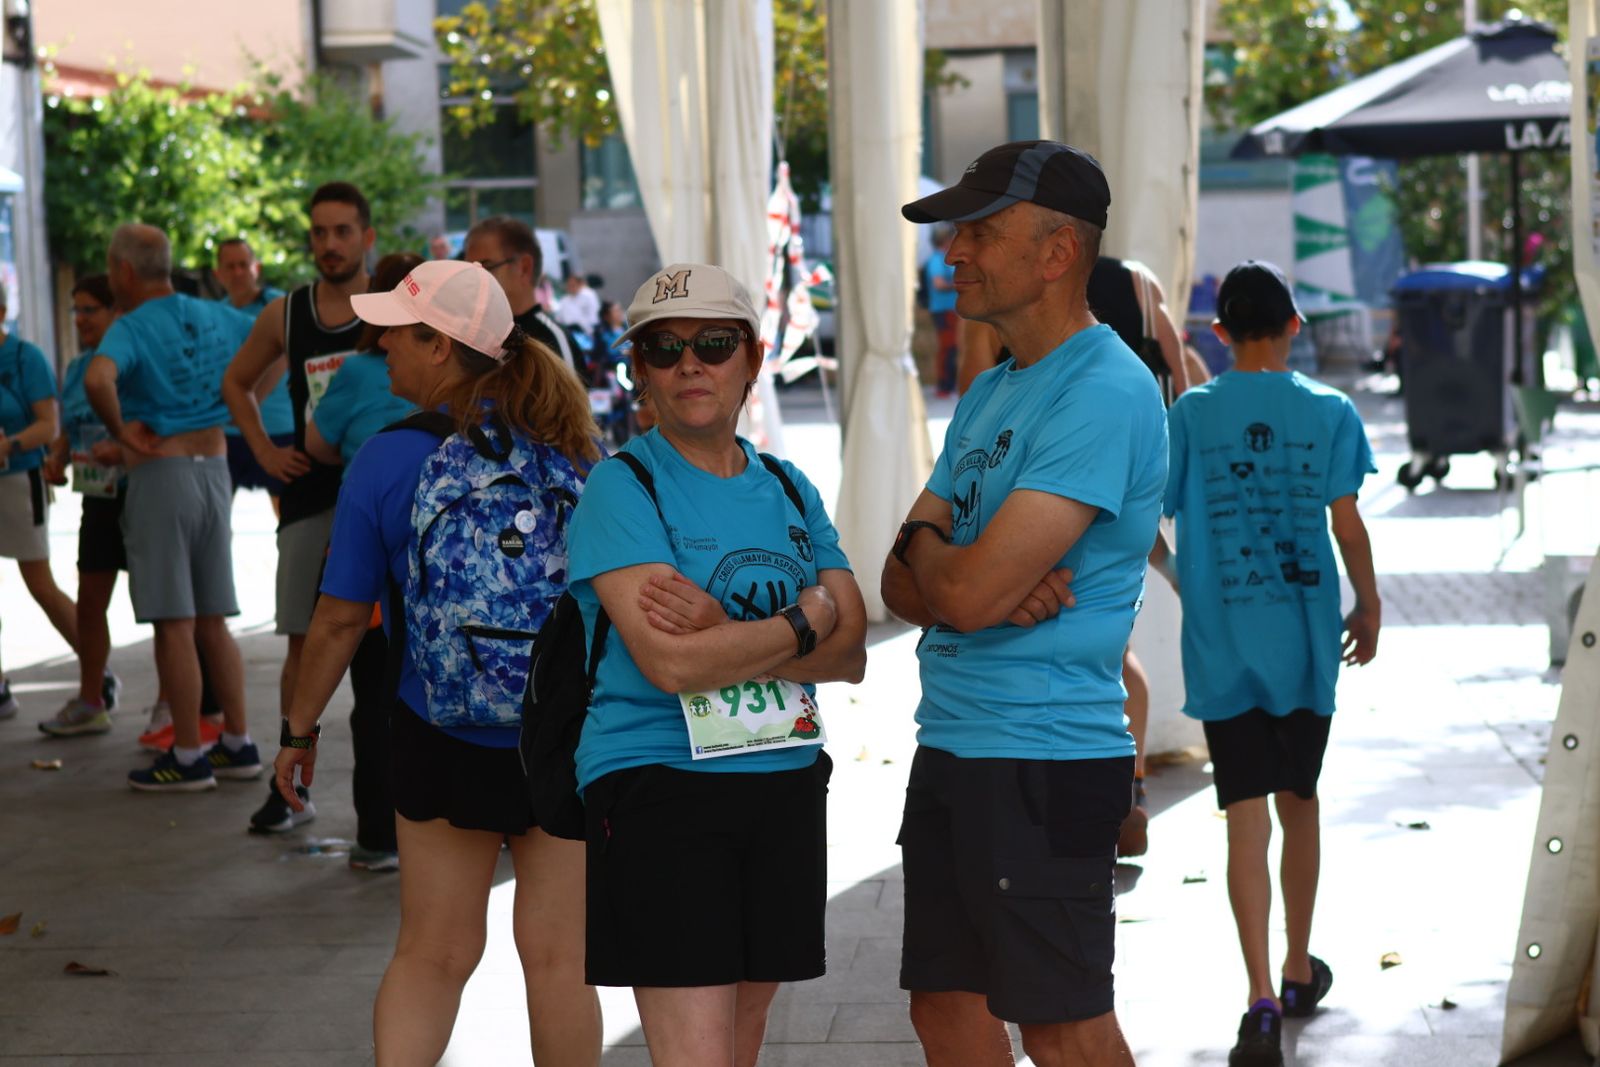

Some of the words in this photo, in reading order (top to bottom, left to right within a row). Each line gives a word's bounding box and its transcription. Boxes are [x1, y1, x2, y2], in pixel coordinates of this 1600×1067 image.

[652, 269, 692, 304] M
[718, 559, 734, 583] CROSS
[732, 552, 772, 568] VILLAMAYOR
[774, 557, 801, 578] ASPACE
[720, 680, 786, 717] 931
